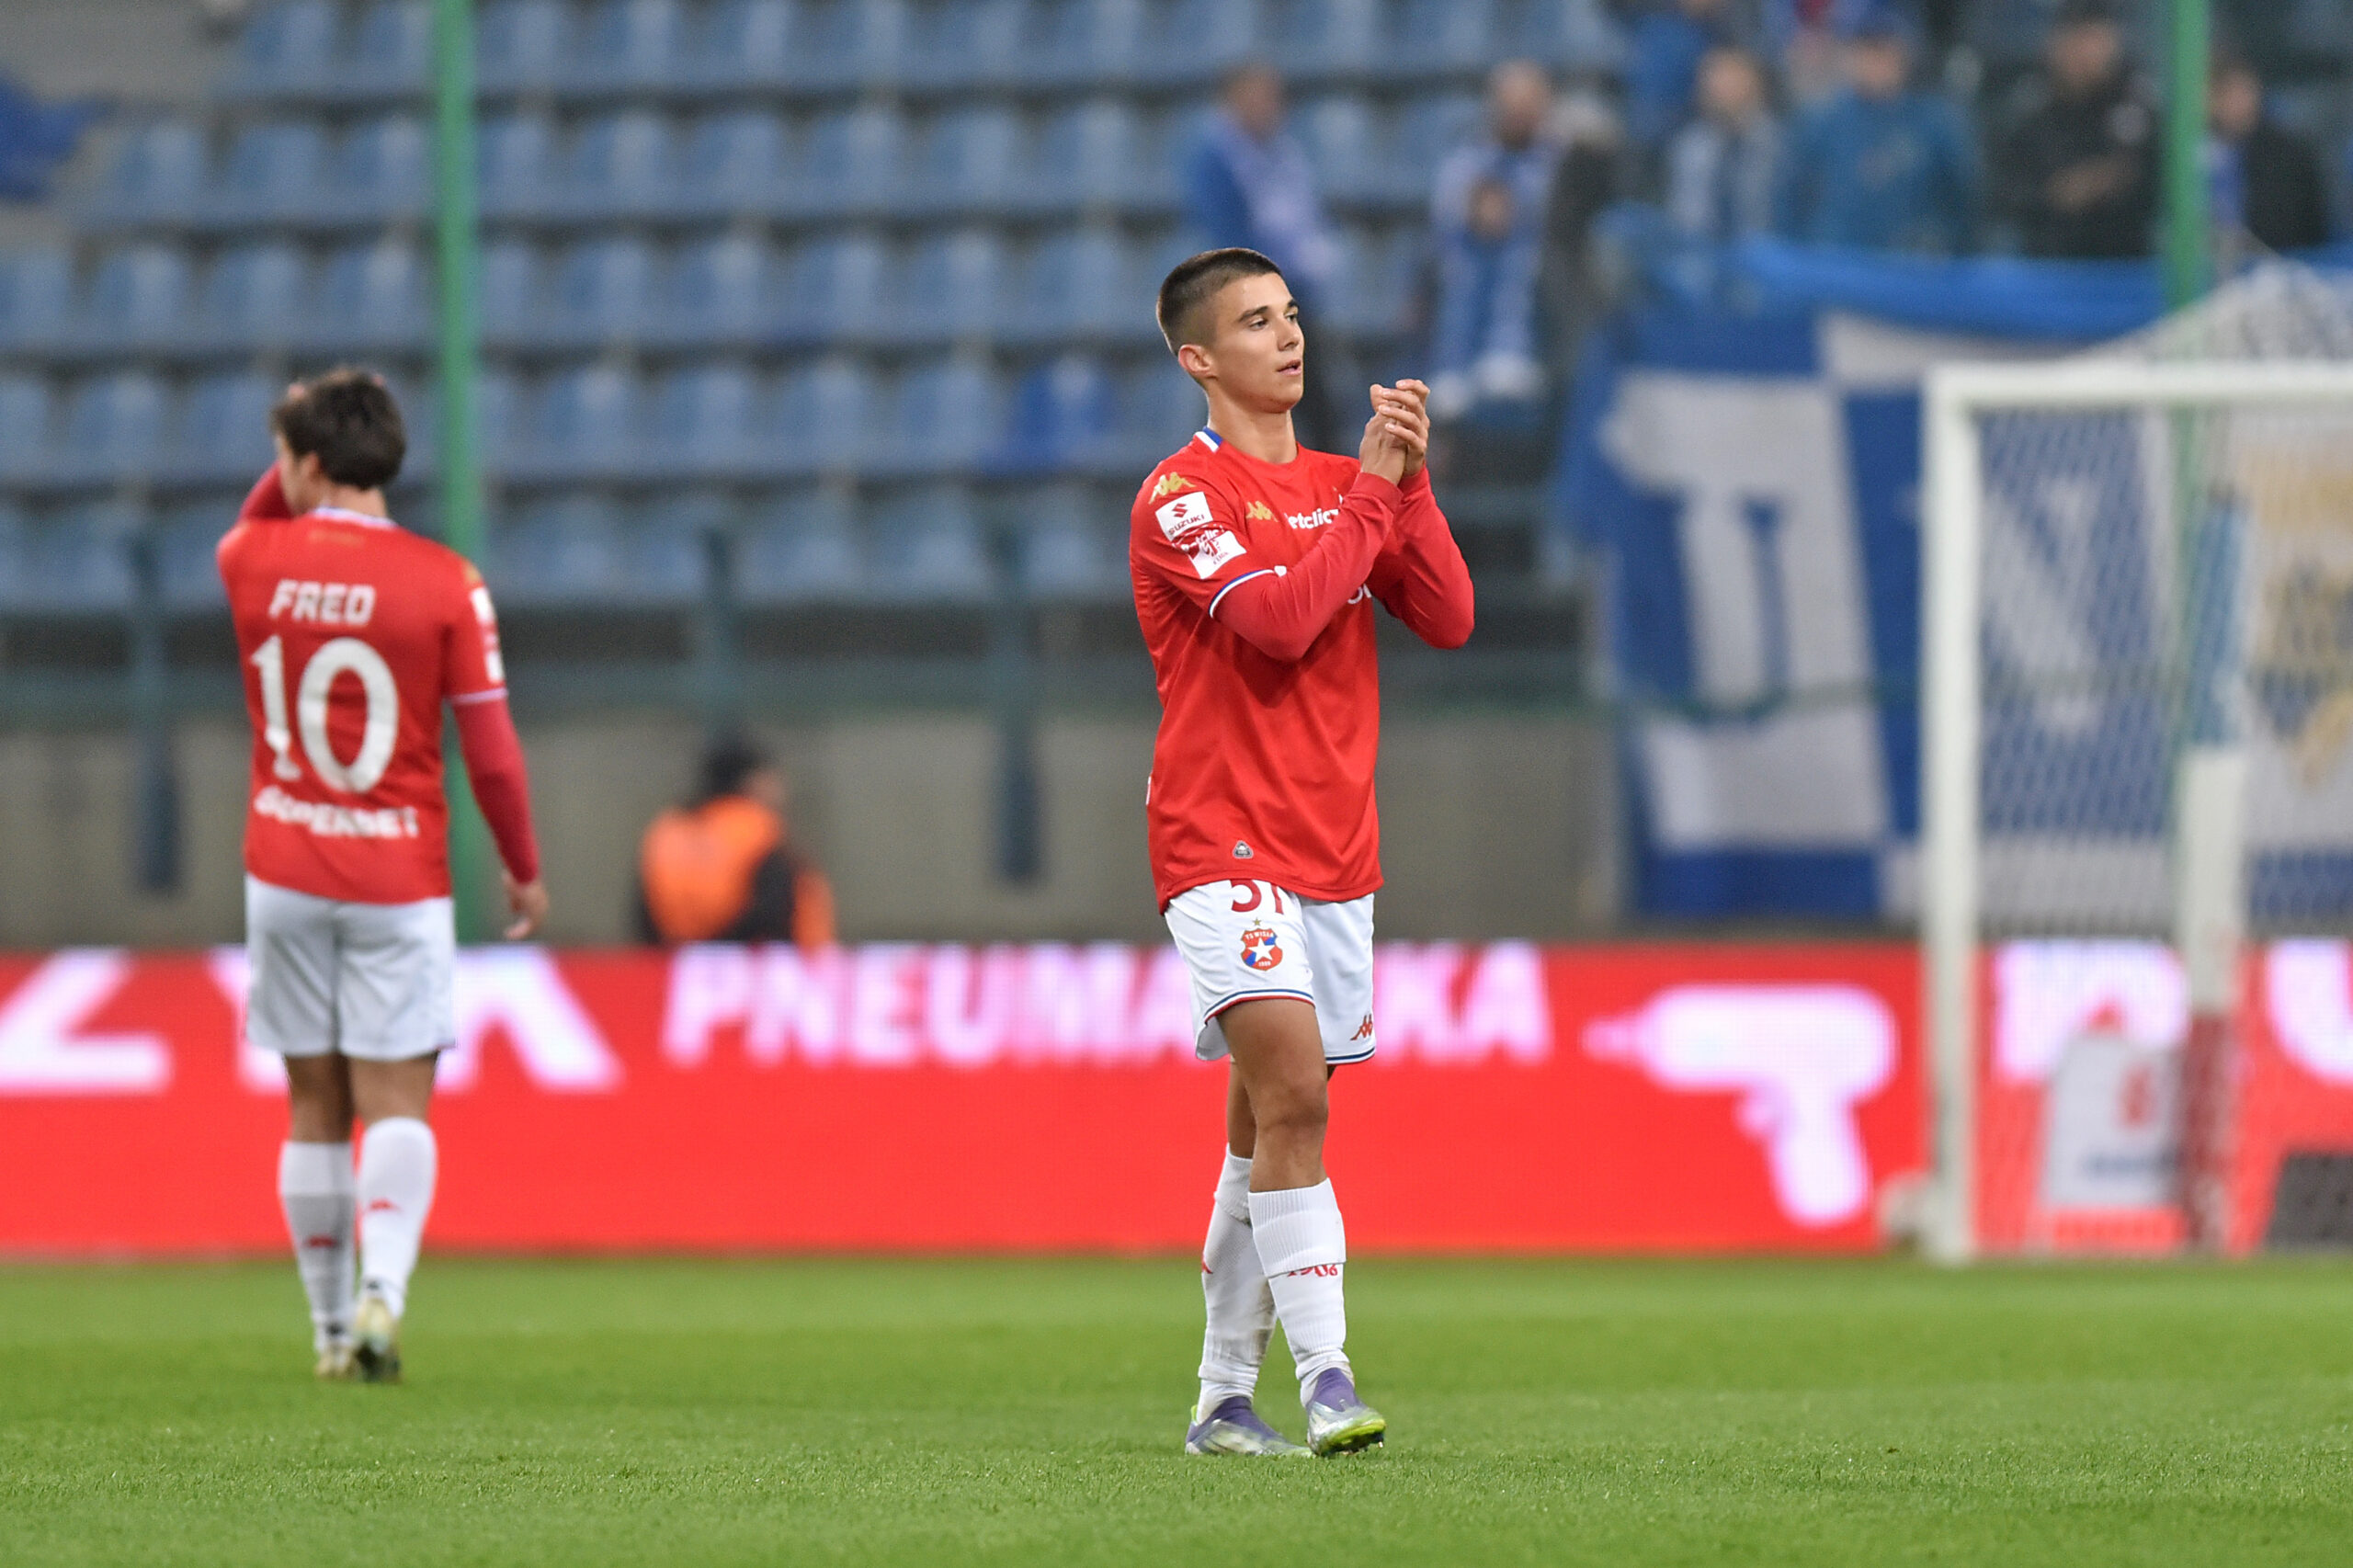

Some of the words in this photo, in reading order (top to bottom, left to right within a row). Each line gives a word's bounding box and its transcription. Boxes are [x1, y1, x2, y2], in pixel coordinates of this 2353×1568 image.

[1168, 514, 1205, 536] SUZUKI
[1284, 508, 1339, 529] etclic
[268, 579, 376, 627] FRED
[250, 634, 400, 793] 10
[1287, 1264, 1338, 1277] 06
